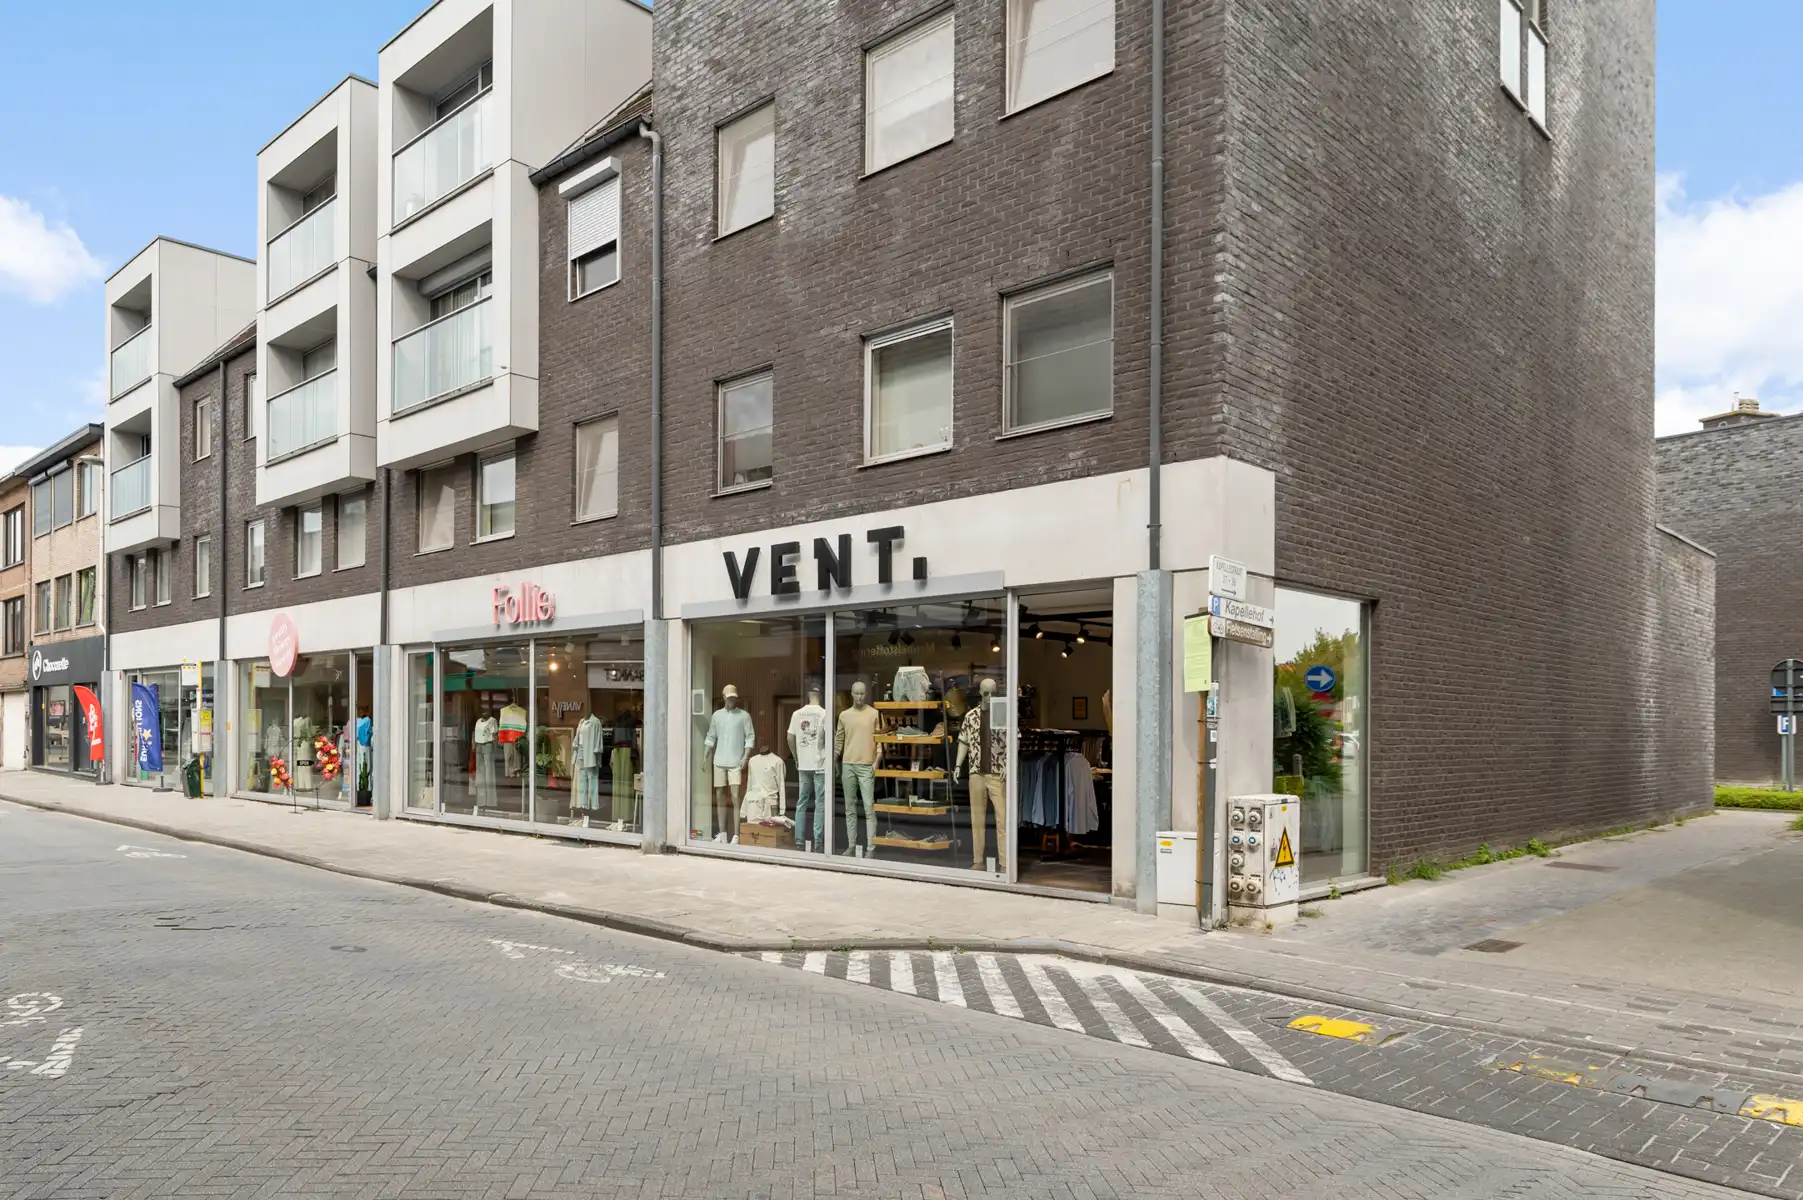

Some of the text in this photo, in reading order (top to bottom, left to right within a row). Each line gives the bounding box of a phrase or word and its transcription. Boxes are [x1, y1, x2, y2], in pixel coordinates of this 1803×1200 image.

[722, 525, 928, 600] VENT.
[492, 582, 556, 624] Follie
[1225, 600, 1265, 622] Kapellehof
